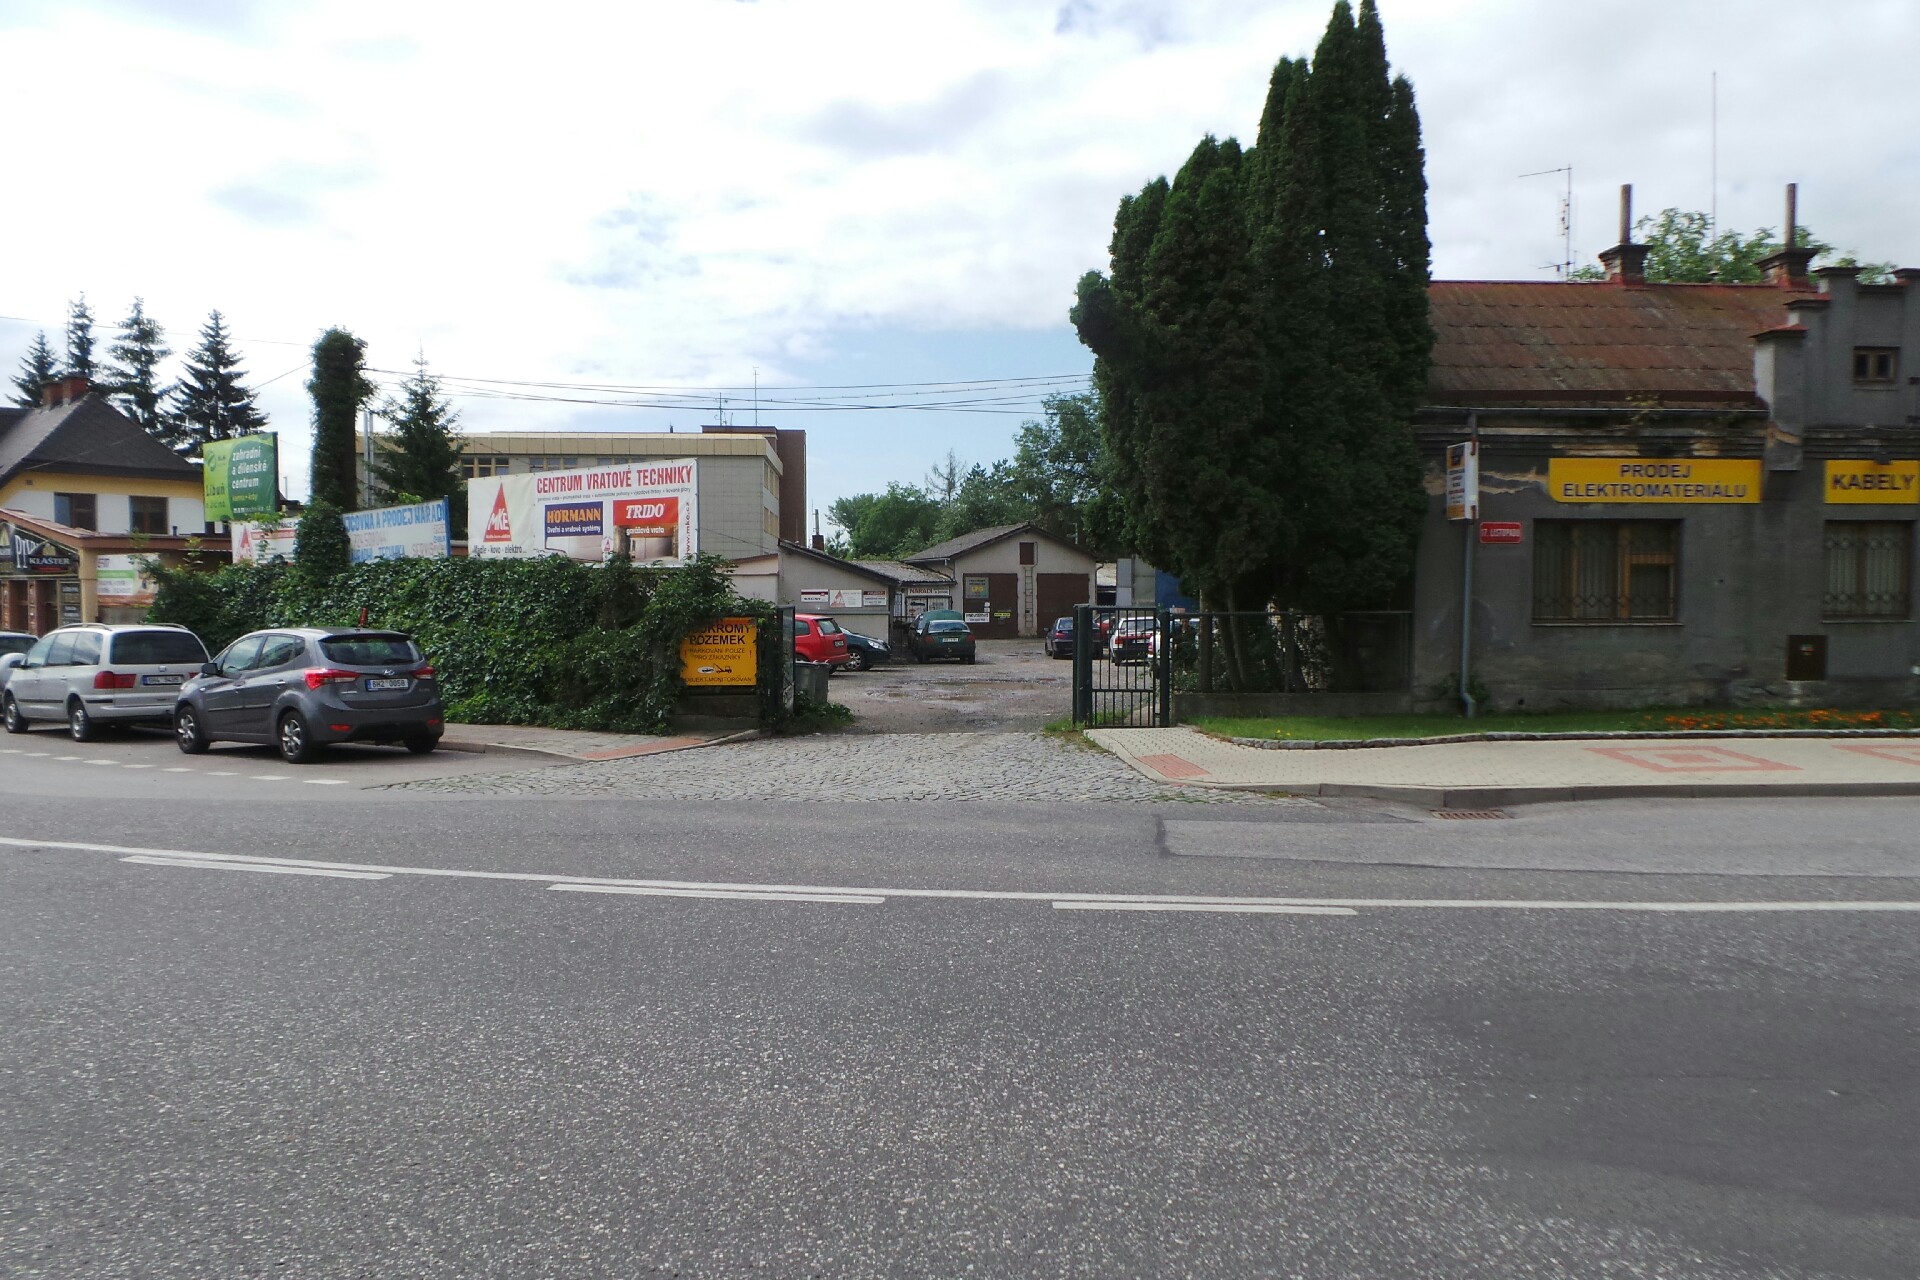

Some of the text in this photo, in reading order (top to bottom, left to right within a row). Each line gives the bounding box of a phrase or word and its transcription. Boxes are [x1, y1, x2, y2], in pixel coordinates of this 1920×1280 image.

[1620, 464, 1691, 478] PRODEJ
[232, 478, 259, 489] centrum
[537, 465, 692, 493] CENTRUM VRATOVÉ TECHNIKY
[1832, 474, 1915, 490] KABELY
[1563, 480, 1746, 498] ELEKTROMATERIÁLU
[382, 508, 413, 528] PRODEJ
[488, 507, 510, 530] MKE
[547, 508, 601, 523] HÖRMANN
[626, 503, 664, 519] TRIDO
[582, 525, 601, 534] systémy
[650, 526, 664, 534] vrata
[689, 635, 745, 645] POZEMEK
